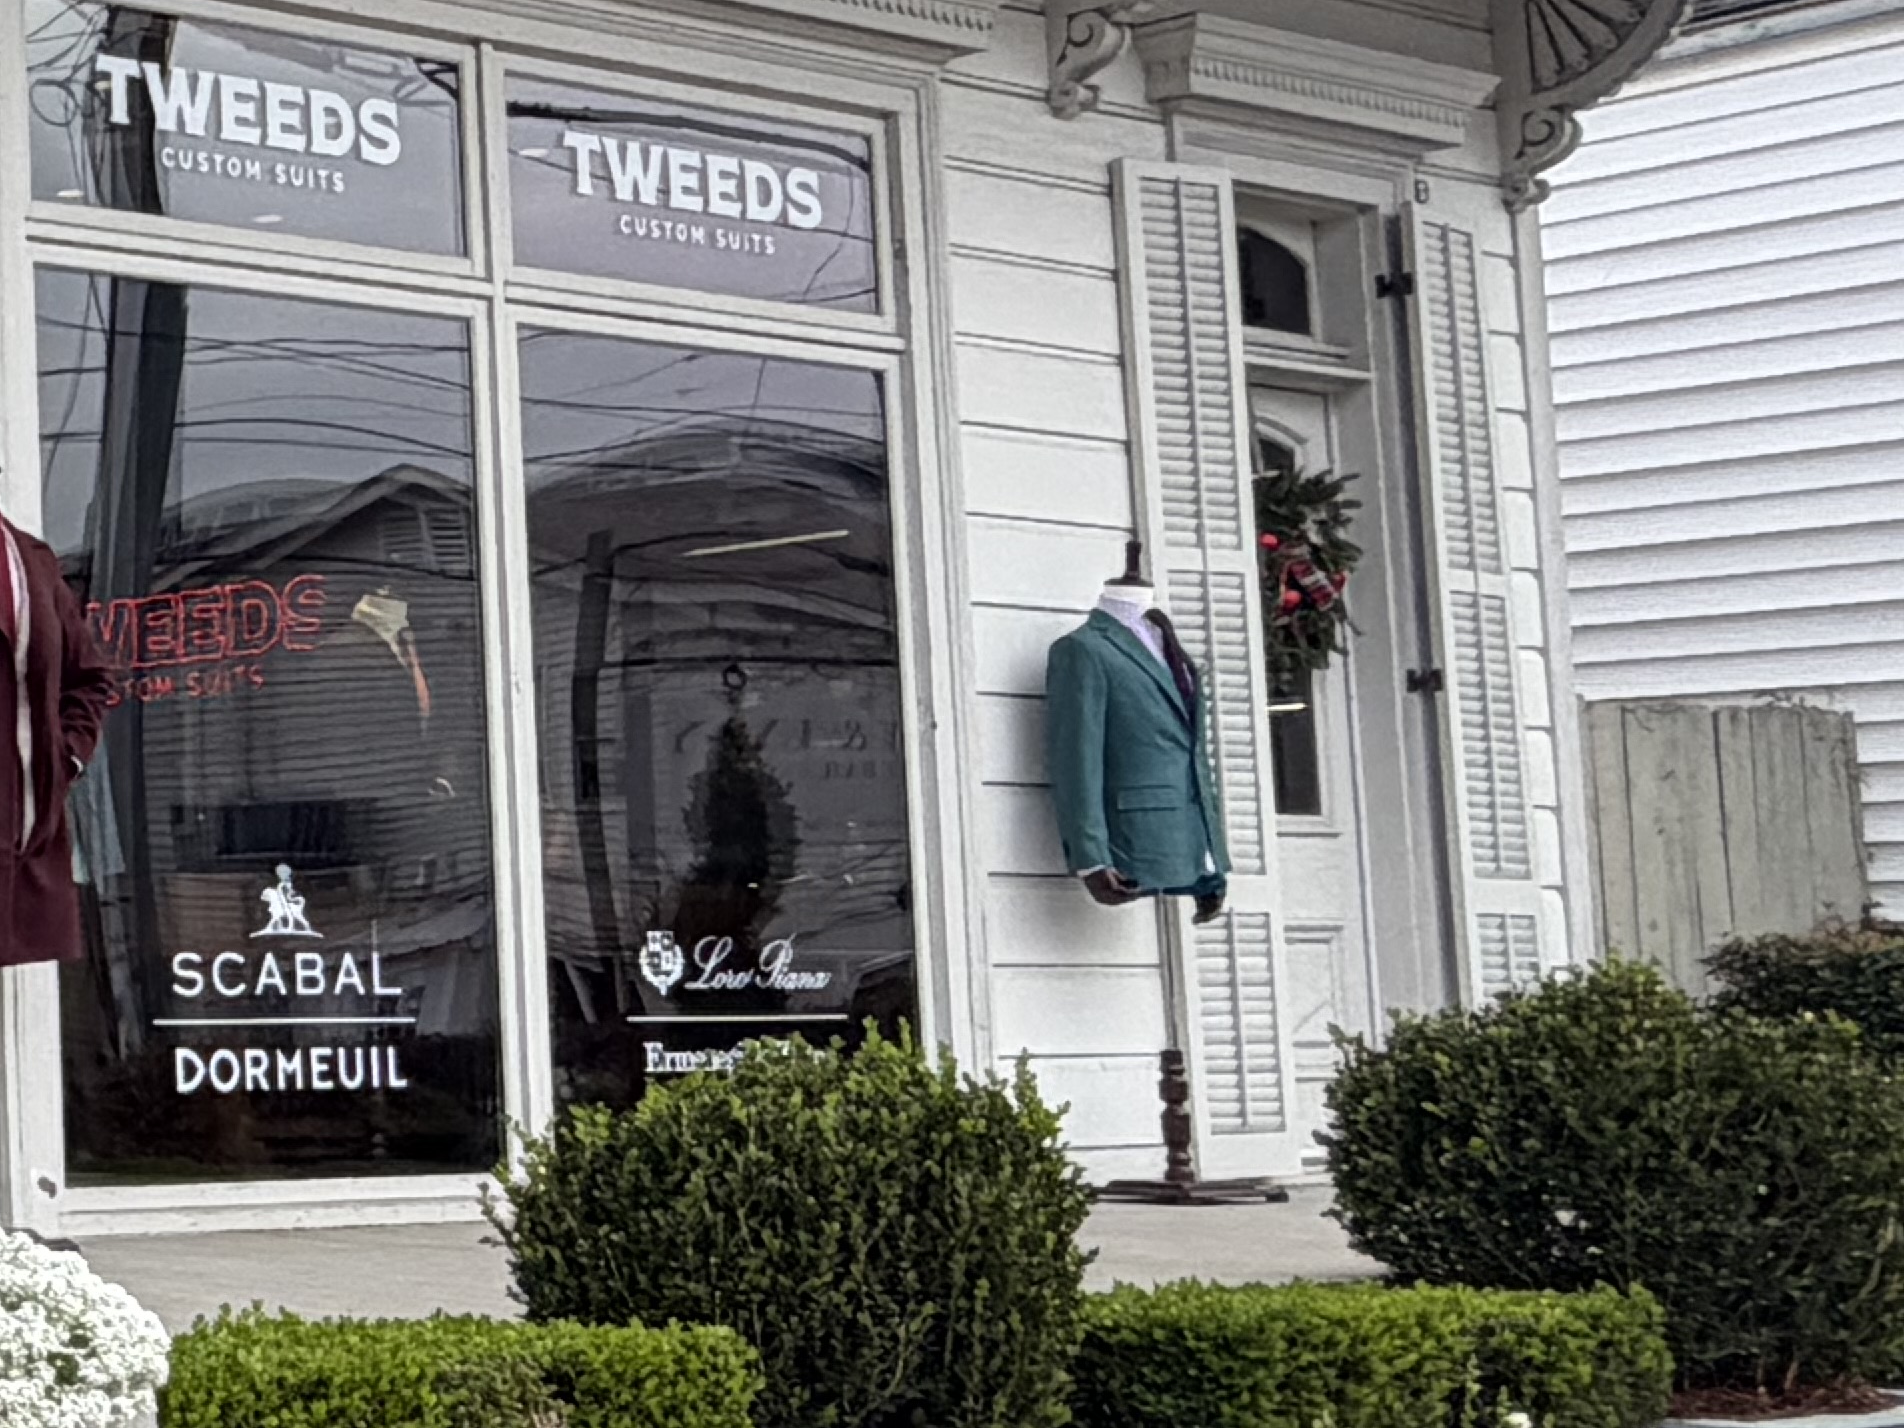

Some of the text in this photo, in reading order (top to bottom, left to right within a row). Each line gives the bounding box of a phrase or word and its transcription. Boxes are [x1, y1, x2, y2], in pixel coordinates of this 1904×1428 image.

[94, 53, 402, 166] TWEEDS
[160, 146, 345, 194] CUSTOM SUITS
[563, 130, 824, 230] TWEEDS
[620, 214, 776, 255] CUSTOM SUITS
[86, 573, 328, 669] WEEDS
[171, 950, 404, 998] SCABAL
[683, 932, 833, 991] Loro Piana
[174, 1045, 409, 1095] DORMEUIL
